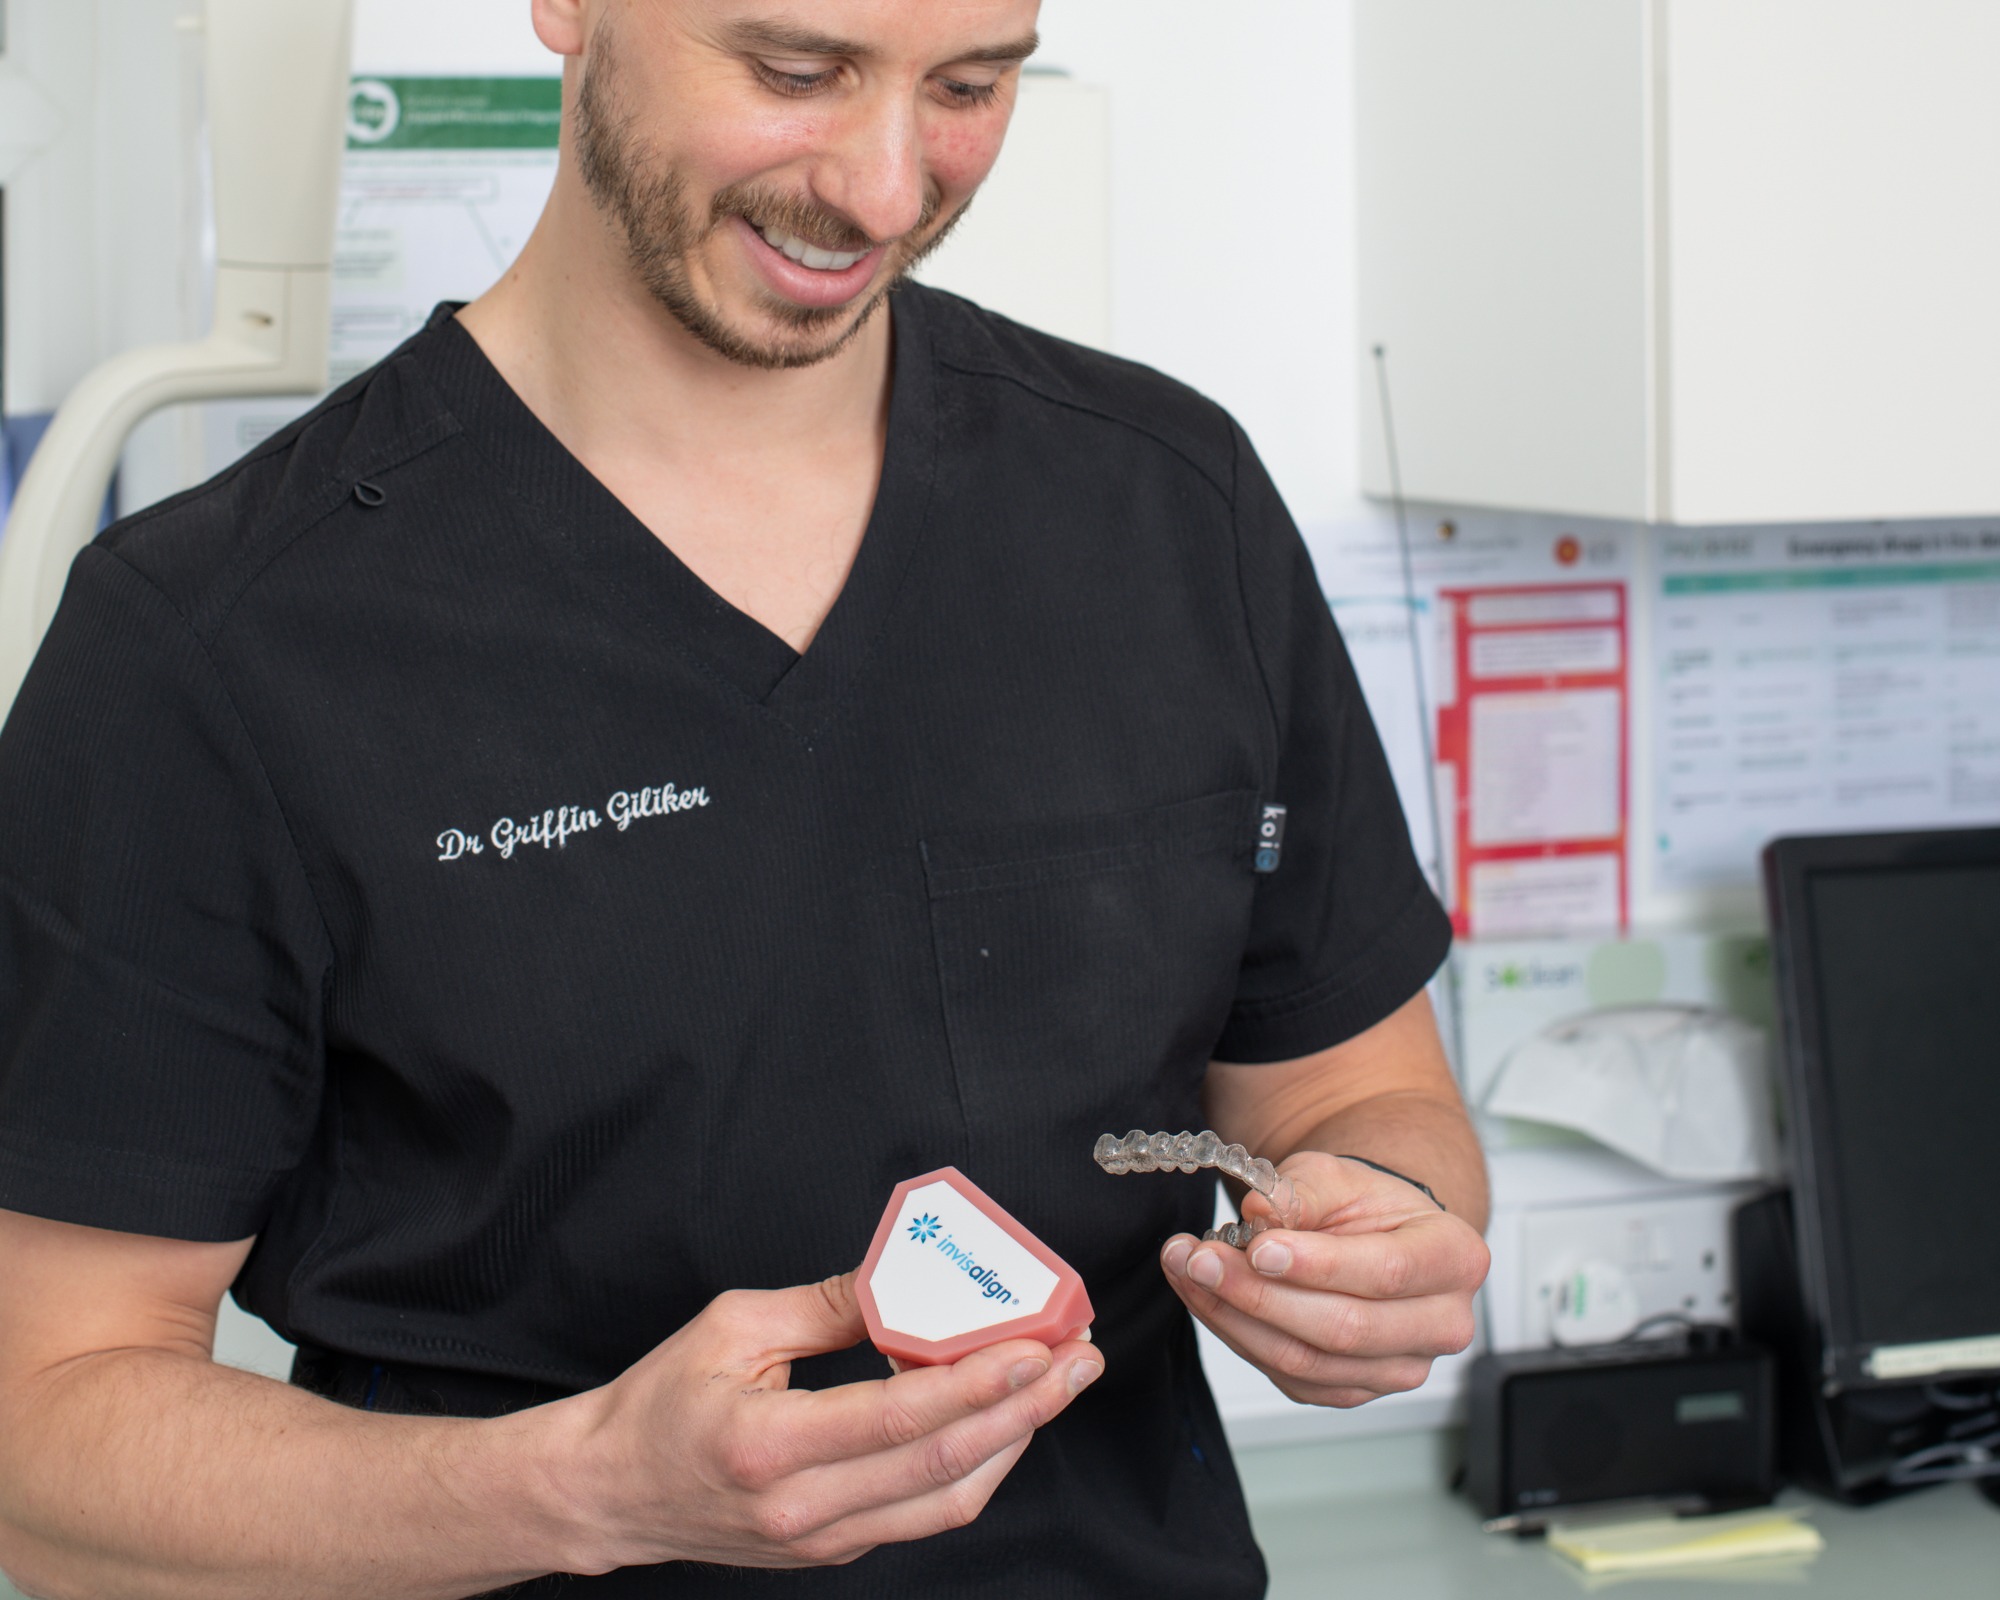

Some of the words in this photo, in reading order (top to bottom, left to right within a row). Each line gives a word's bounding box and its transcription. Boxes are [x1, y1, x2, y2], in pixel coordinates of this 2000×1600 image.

[436, 829, 483, 861] Dr
[490, 806, 602, 859] Griffin
[606, 783, 710, 832] Giliker
[1260, 806, 1286, 849] koi
[936, 1234, 1013, 1304] invisalign
